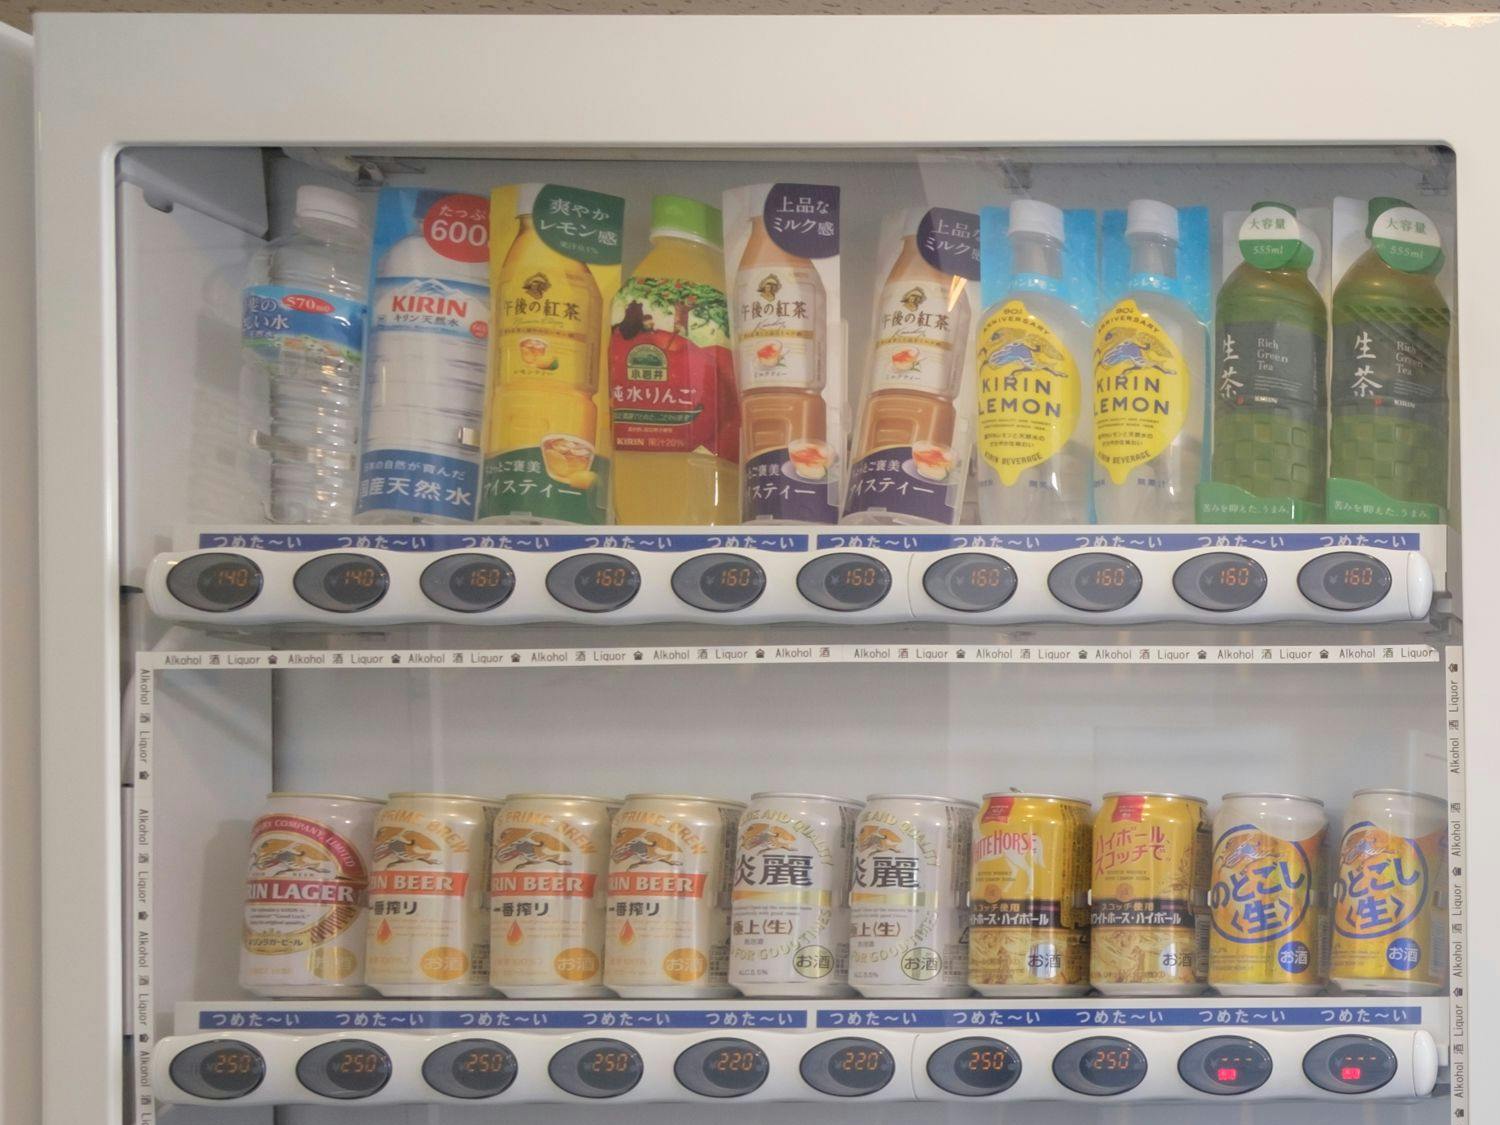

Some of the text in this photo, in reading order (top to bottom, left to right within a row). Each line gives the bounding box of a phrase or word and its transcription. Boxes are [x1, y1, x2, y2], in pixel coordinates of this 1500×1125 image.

[551, 198, 609, 221] 爽やか
[778, 196, 829, 215] 上品な
[1250, 217, 1286, 229] 大容量
[1387, 217, 1427, 235] 大容量
[392, 295, 468, 318] KIRIN
[741, 300, 808, 322] 午後の紅茶
[1257, 338, 1279, 349] Rich
[1219, 334, 1244, 398] 生茶
[1257, 350, 1288, 364] Green
[1257, 360, 1274, 371] Tea
[1351, 331, 1383, 398] 生茶
[982, 376, 1051, 395] KIRIN
[1096, 376, 1160, 393] KIRIN
[978, 398, 1061, 417] LEMON
[218, 569, 247, 587] 140
[471, 569, 500, 587] 160
[597, 569, 625, 587] 160
[721, 569, 750, 587] 160
[845, 567, 875, 585] 160
[970, 567, 999, 585] 160
[1095, 567, 1124, 585] 160
[1220, 567, 1248, 585] 160
[1344, 567, 1372, 585] 160
[165, 655, 260, 666] Alkohol Liquor
[854, 648, 890, 658] Alkohol
[916, 648, 948, 660] Liquor
[976, 648, 1012, 658] Alkohol
[1038, 648, 1071, 660] Liquor
[1450, 820, 1464, 916] Alkohol Liquor
[272, 882, 355, 902] LAGER
[393, 876, 455, 891] BEER
[523, 876, 583, 892] BEER
[636, 876, 693, 892] BEER
[797, 955, 834, 970] お酒
[1028, 953, 1062, 969] お酒
[1280, 949, 1308, 966] お酒
[1389, 945, 1417, 963] お酒
[215, 1053, 251, 1073] 250
[467, 1053, 502, 1073] 250
[594, 1053, 627, 1073] 250
[717, 1052, 753, 1071] 220
[843, 1052, 878, 1071] 220
[968, 1052, 1004, 1071] 250
[1094, 1052, 1129, 1071] 250
